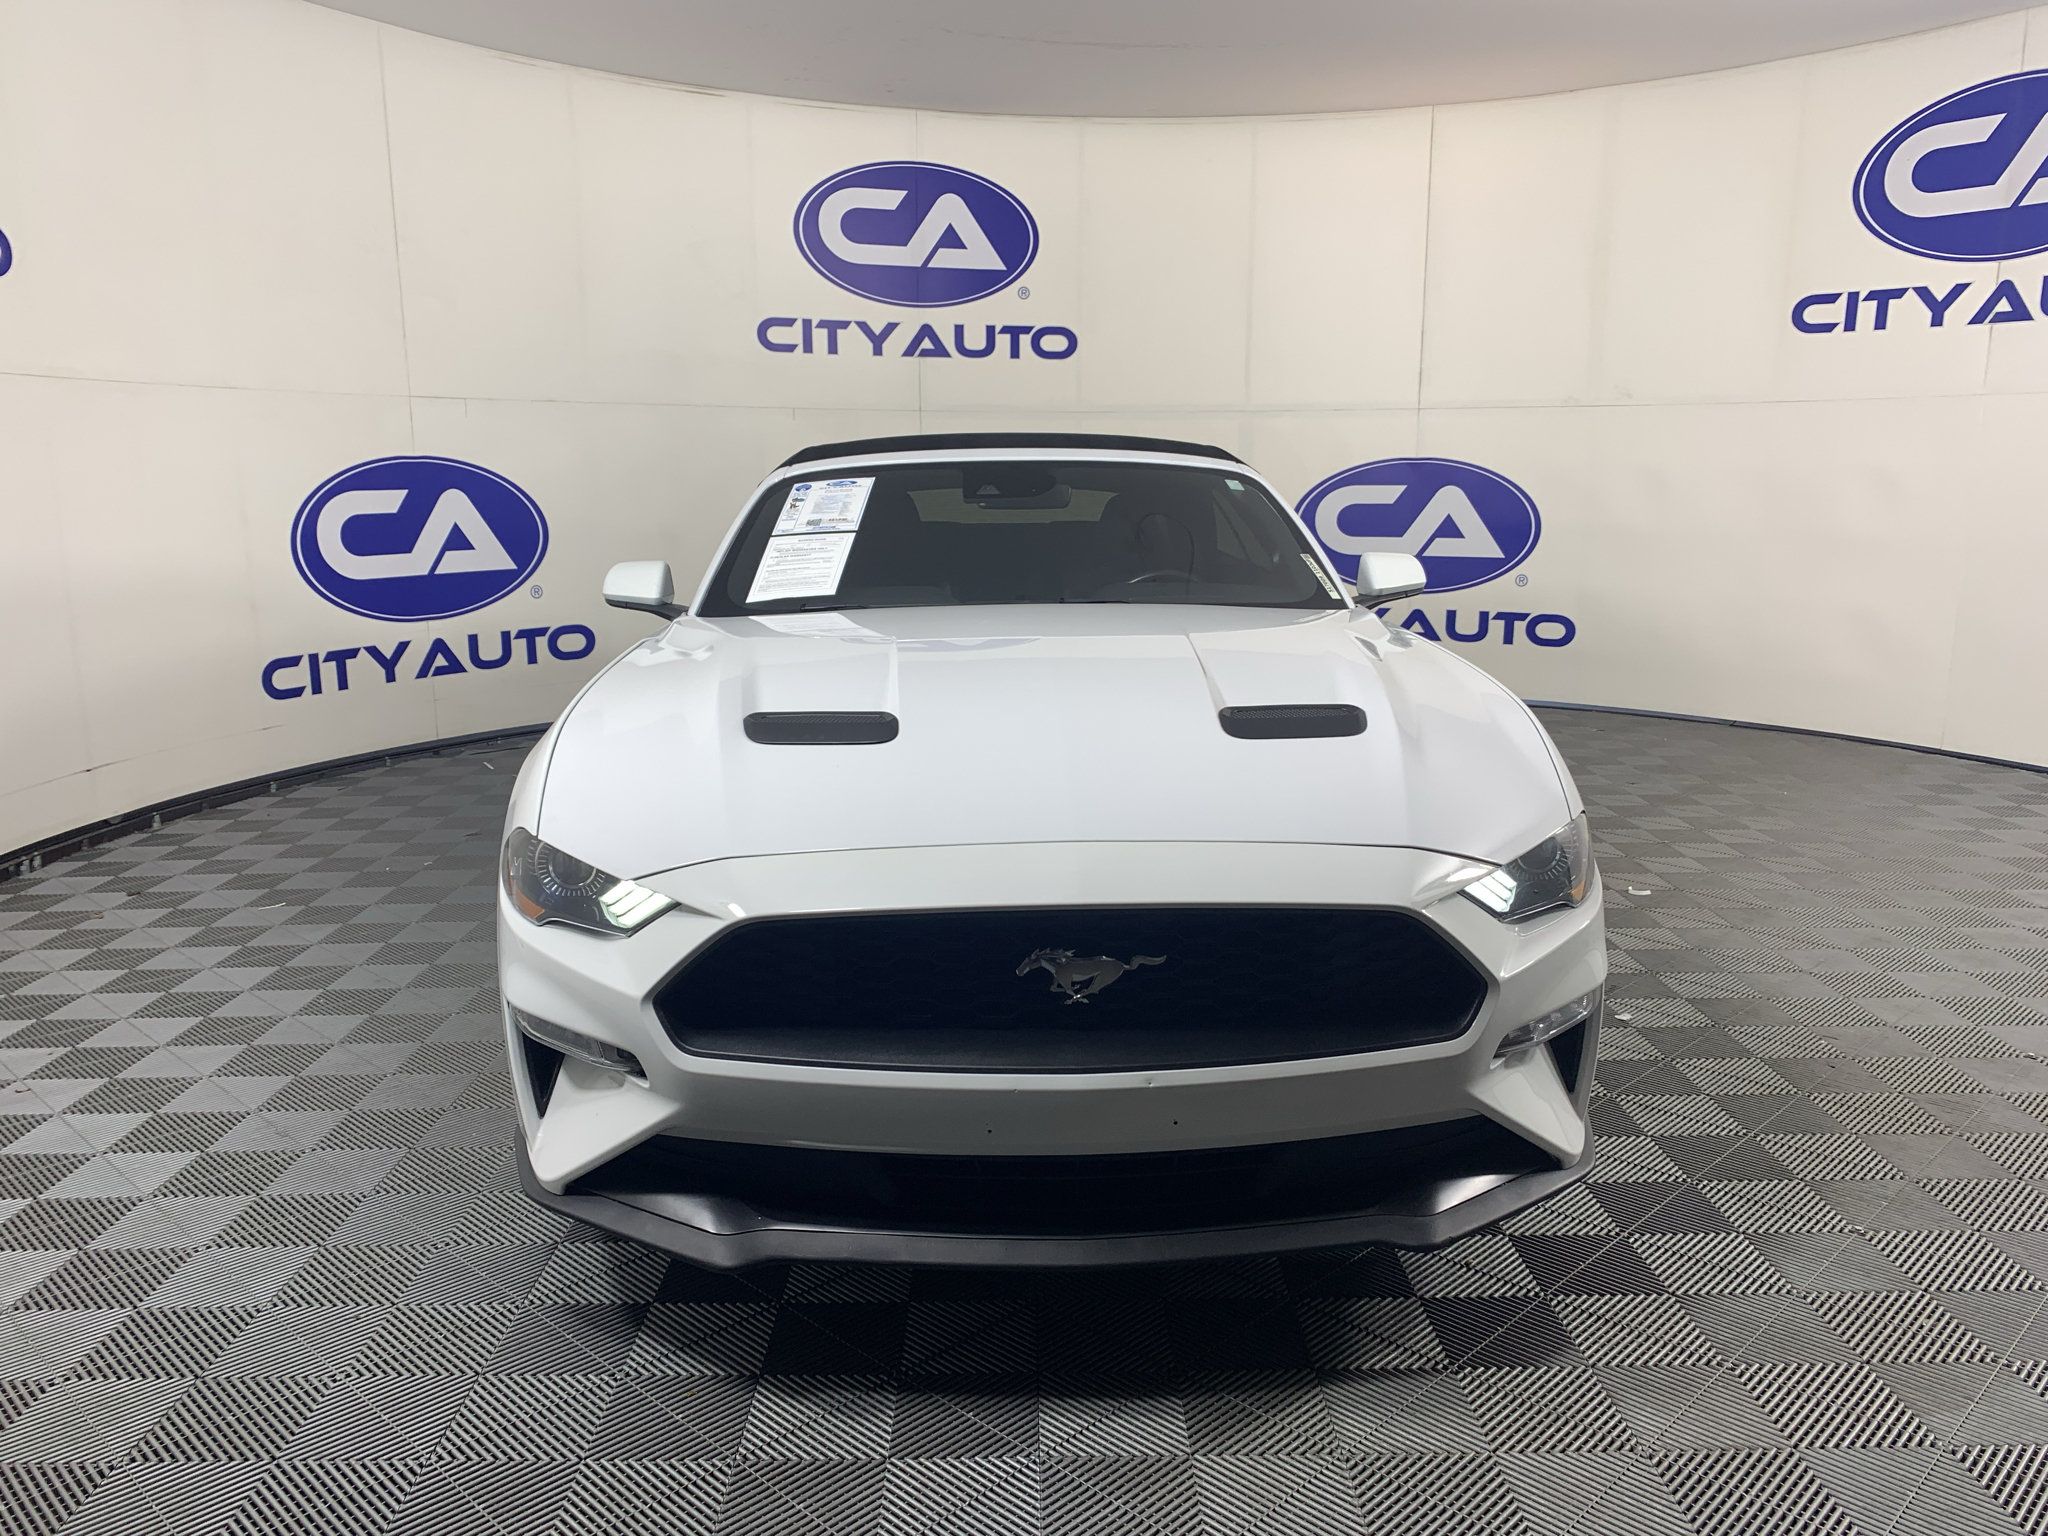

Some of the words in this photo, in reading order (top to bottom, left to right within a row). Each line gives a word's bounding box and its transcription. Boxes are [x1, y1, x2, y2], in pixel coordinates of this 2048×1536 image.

[818, 187, 1007, 271] CA
[757, 317, 900, 356] CITY
[901, 323, 1078, 360] AUTO
[1792, 282, 1973, 333] CITY
[317, 488, 518, 580] CA
[1315, 485, 1505, 559] CA
[261, 640, 411, 700] CITY
[415, 624, 596, 679] AUTO
[1400, 608, 1576, 647] AUTO
